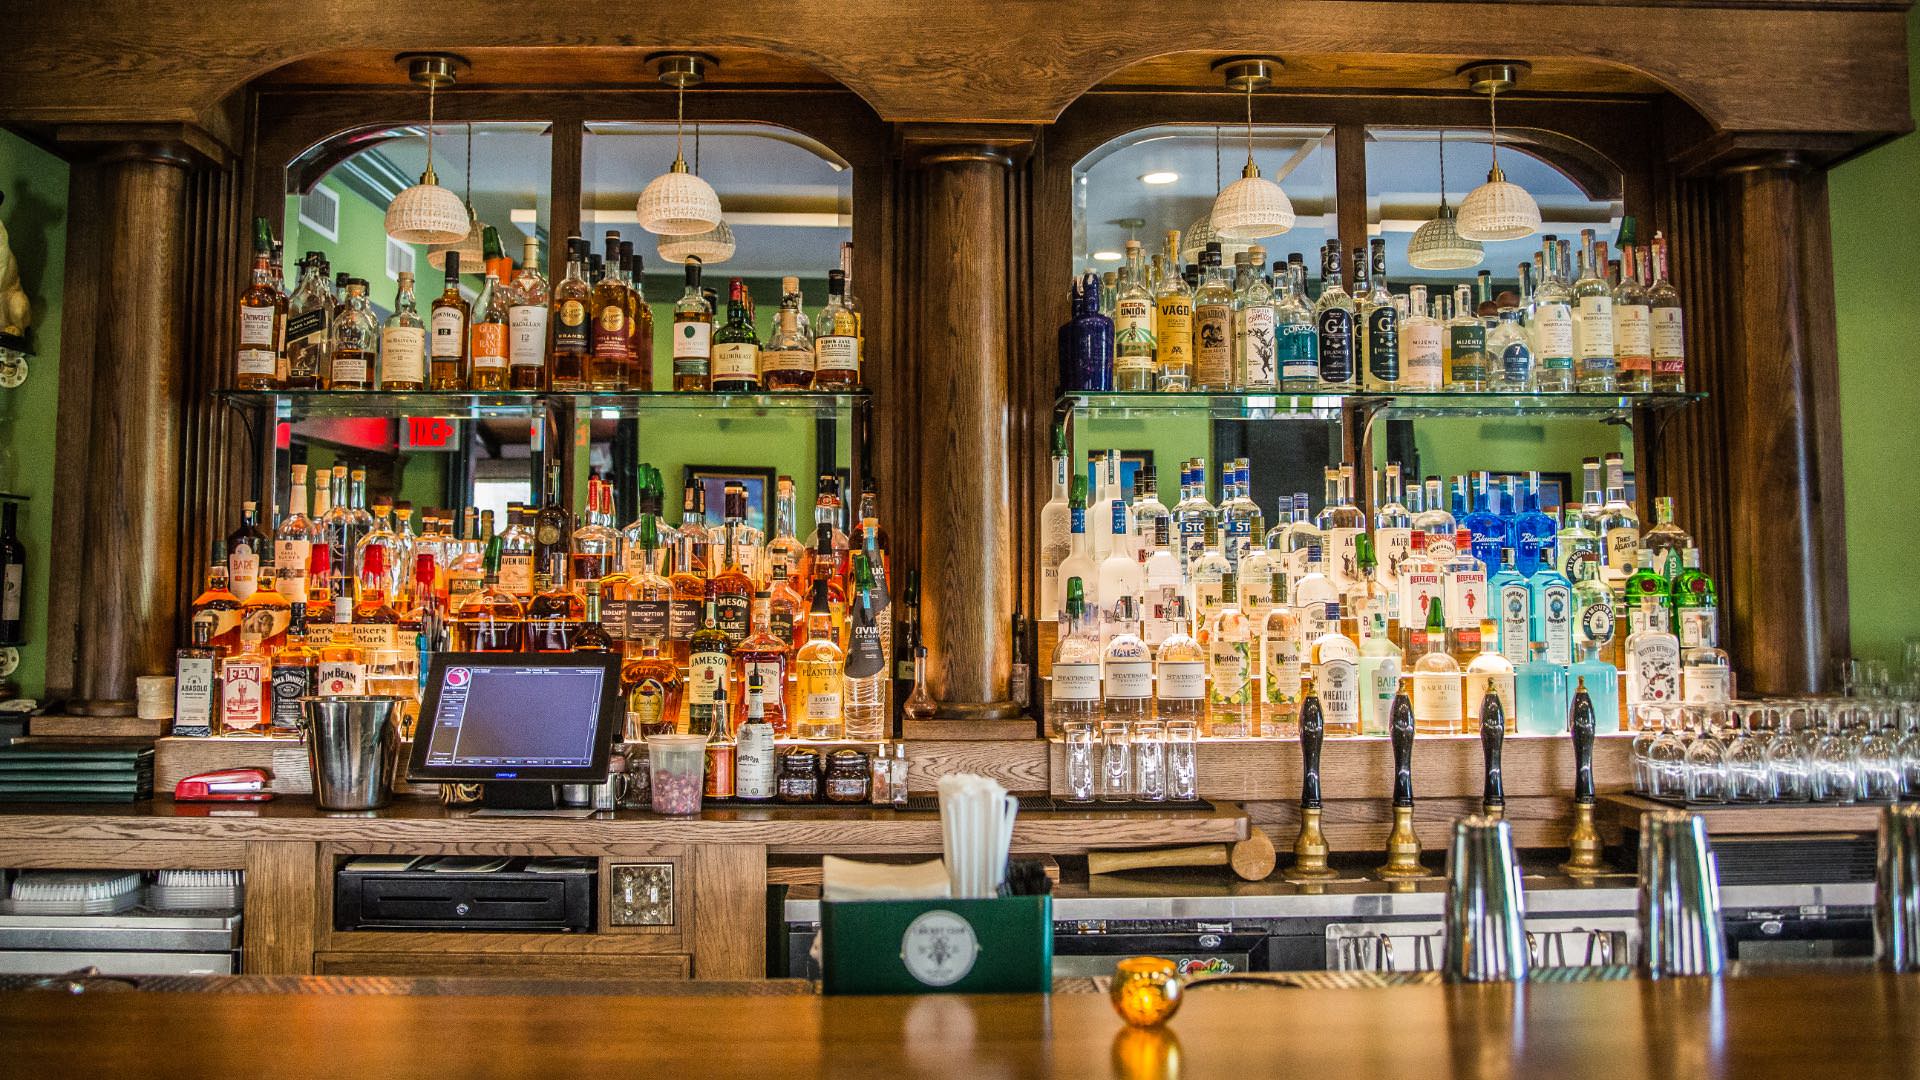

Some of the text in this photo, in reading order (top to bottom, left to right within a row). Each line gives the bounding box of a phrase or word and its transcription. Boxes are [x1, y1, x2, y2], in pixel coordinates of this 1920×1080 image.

[1162, 305, 1189, 316] VAGO
[432, 312, 461, 321] BOWMORE
[1325, 318, 1348, 334] G4
[1410, 575, 1438, 584] BEEFEATER
[1456, 574, 1484, 583] BEEFEATER
[357, 635, 386, 643] Mark
[691, 655, 728, 668] JAMESON
[229, 667, 257, 681] FEW
[320, 667, 357, 683] JIM BEAM
[1328, 702, 1348, 711] VODKA
